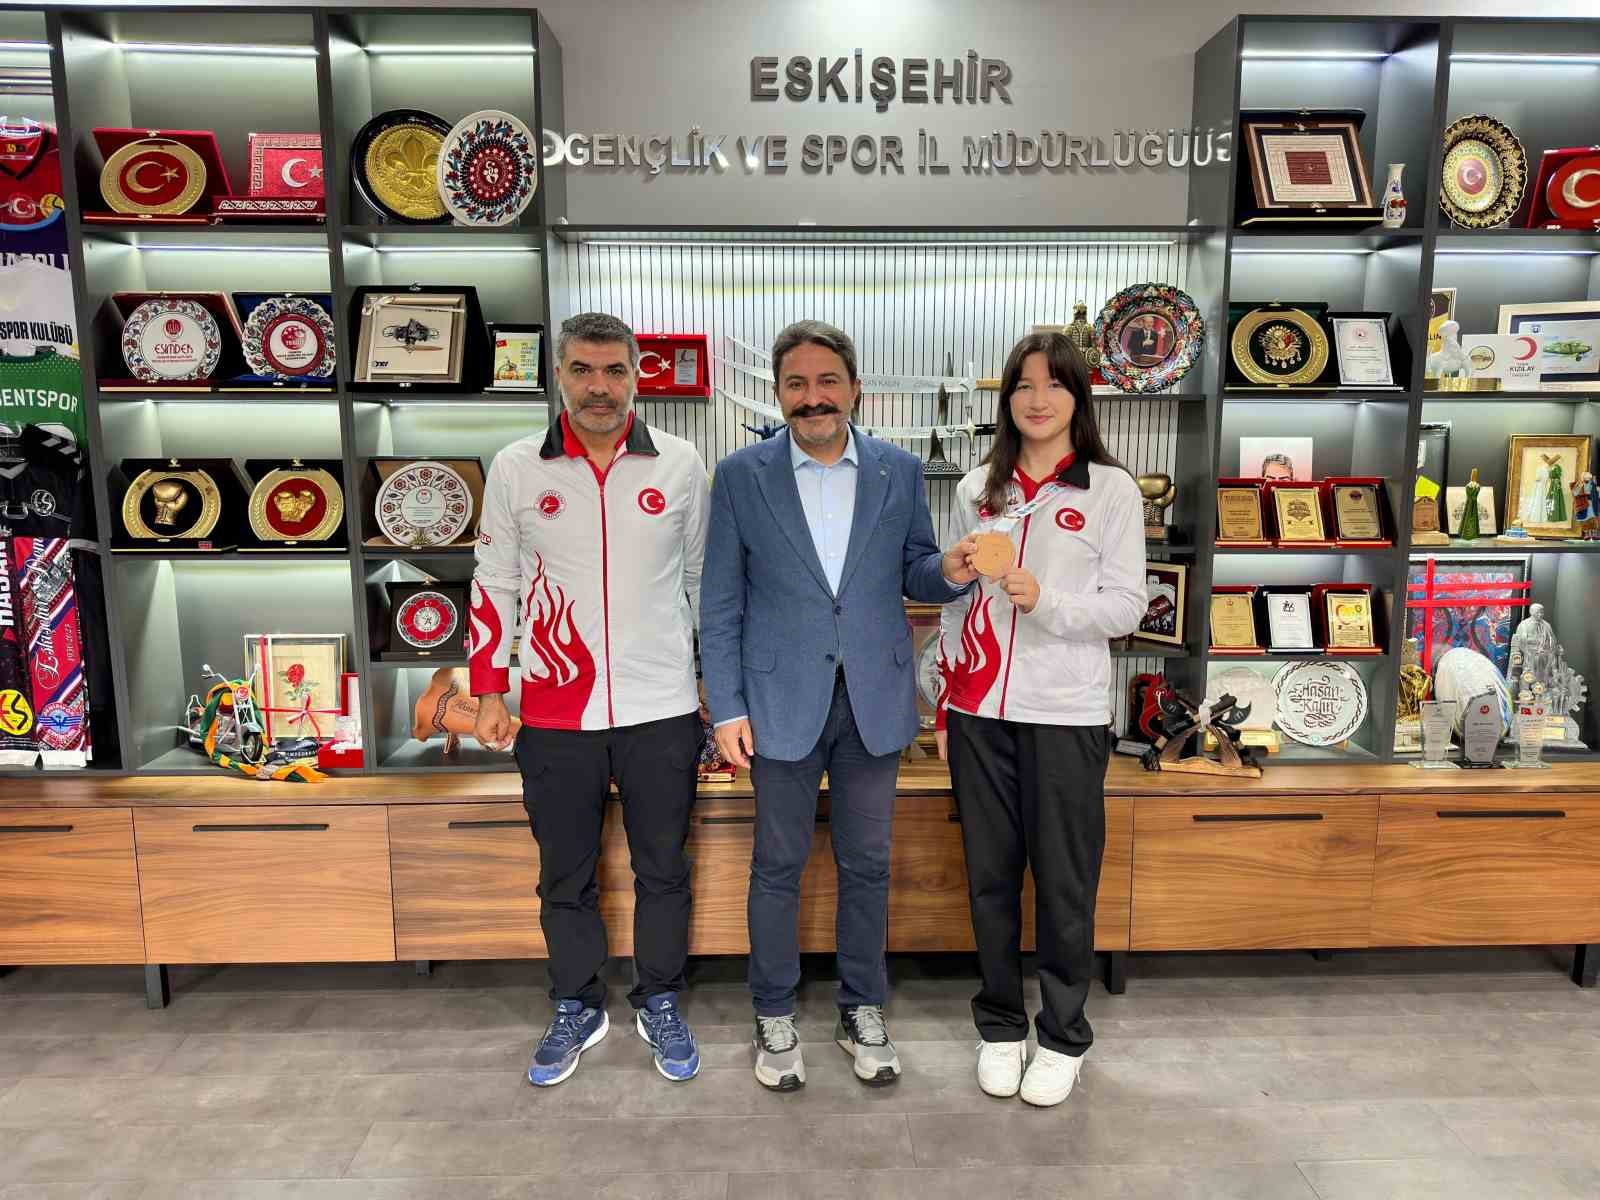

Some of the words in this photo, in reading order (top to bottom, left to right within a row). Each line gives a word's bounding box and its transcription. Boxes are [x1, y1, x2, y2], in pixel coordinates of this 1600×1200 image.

[751, 48, 1012, 112] ESKİŞEHİR
[564, 127, 731, 175] GENÇLİK
[736, 134, 788, 172] VE
[802, 133, 905, 172] SPOR
[917, 127, 950, 172] İL
[960, 128, 1190, 172] MÜDÜRLÜĞÜ
[0, 321, 29, 340] SPOR
[30, 321, 73, 346] KULÜBÜ
[0, 388, 78, 413] ENTSPOR
